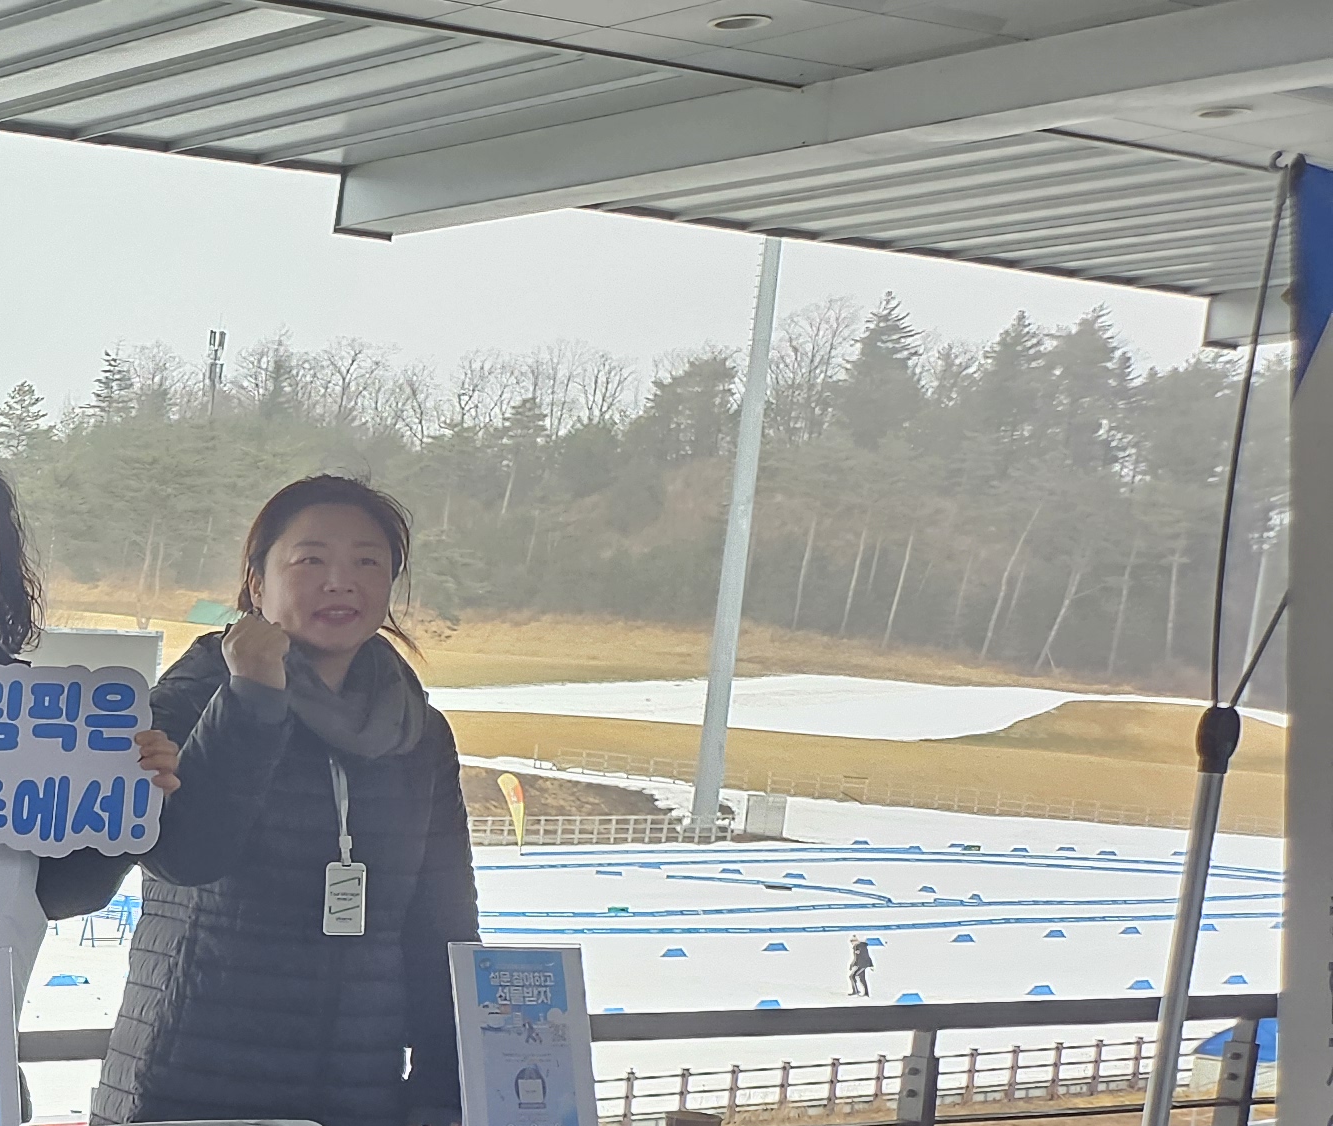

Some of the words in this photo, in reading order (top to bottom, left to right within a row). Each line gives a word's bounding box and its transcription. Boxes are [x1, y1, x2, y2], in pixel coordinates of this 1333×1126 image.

[489, 972, 511, 986] 설문
[512, 971, 555, 986] 참여하고
[496, 986, 552, 1005] 선물받자
